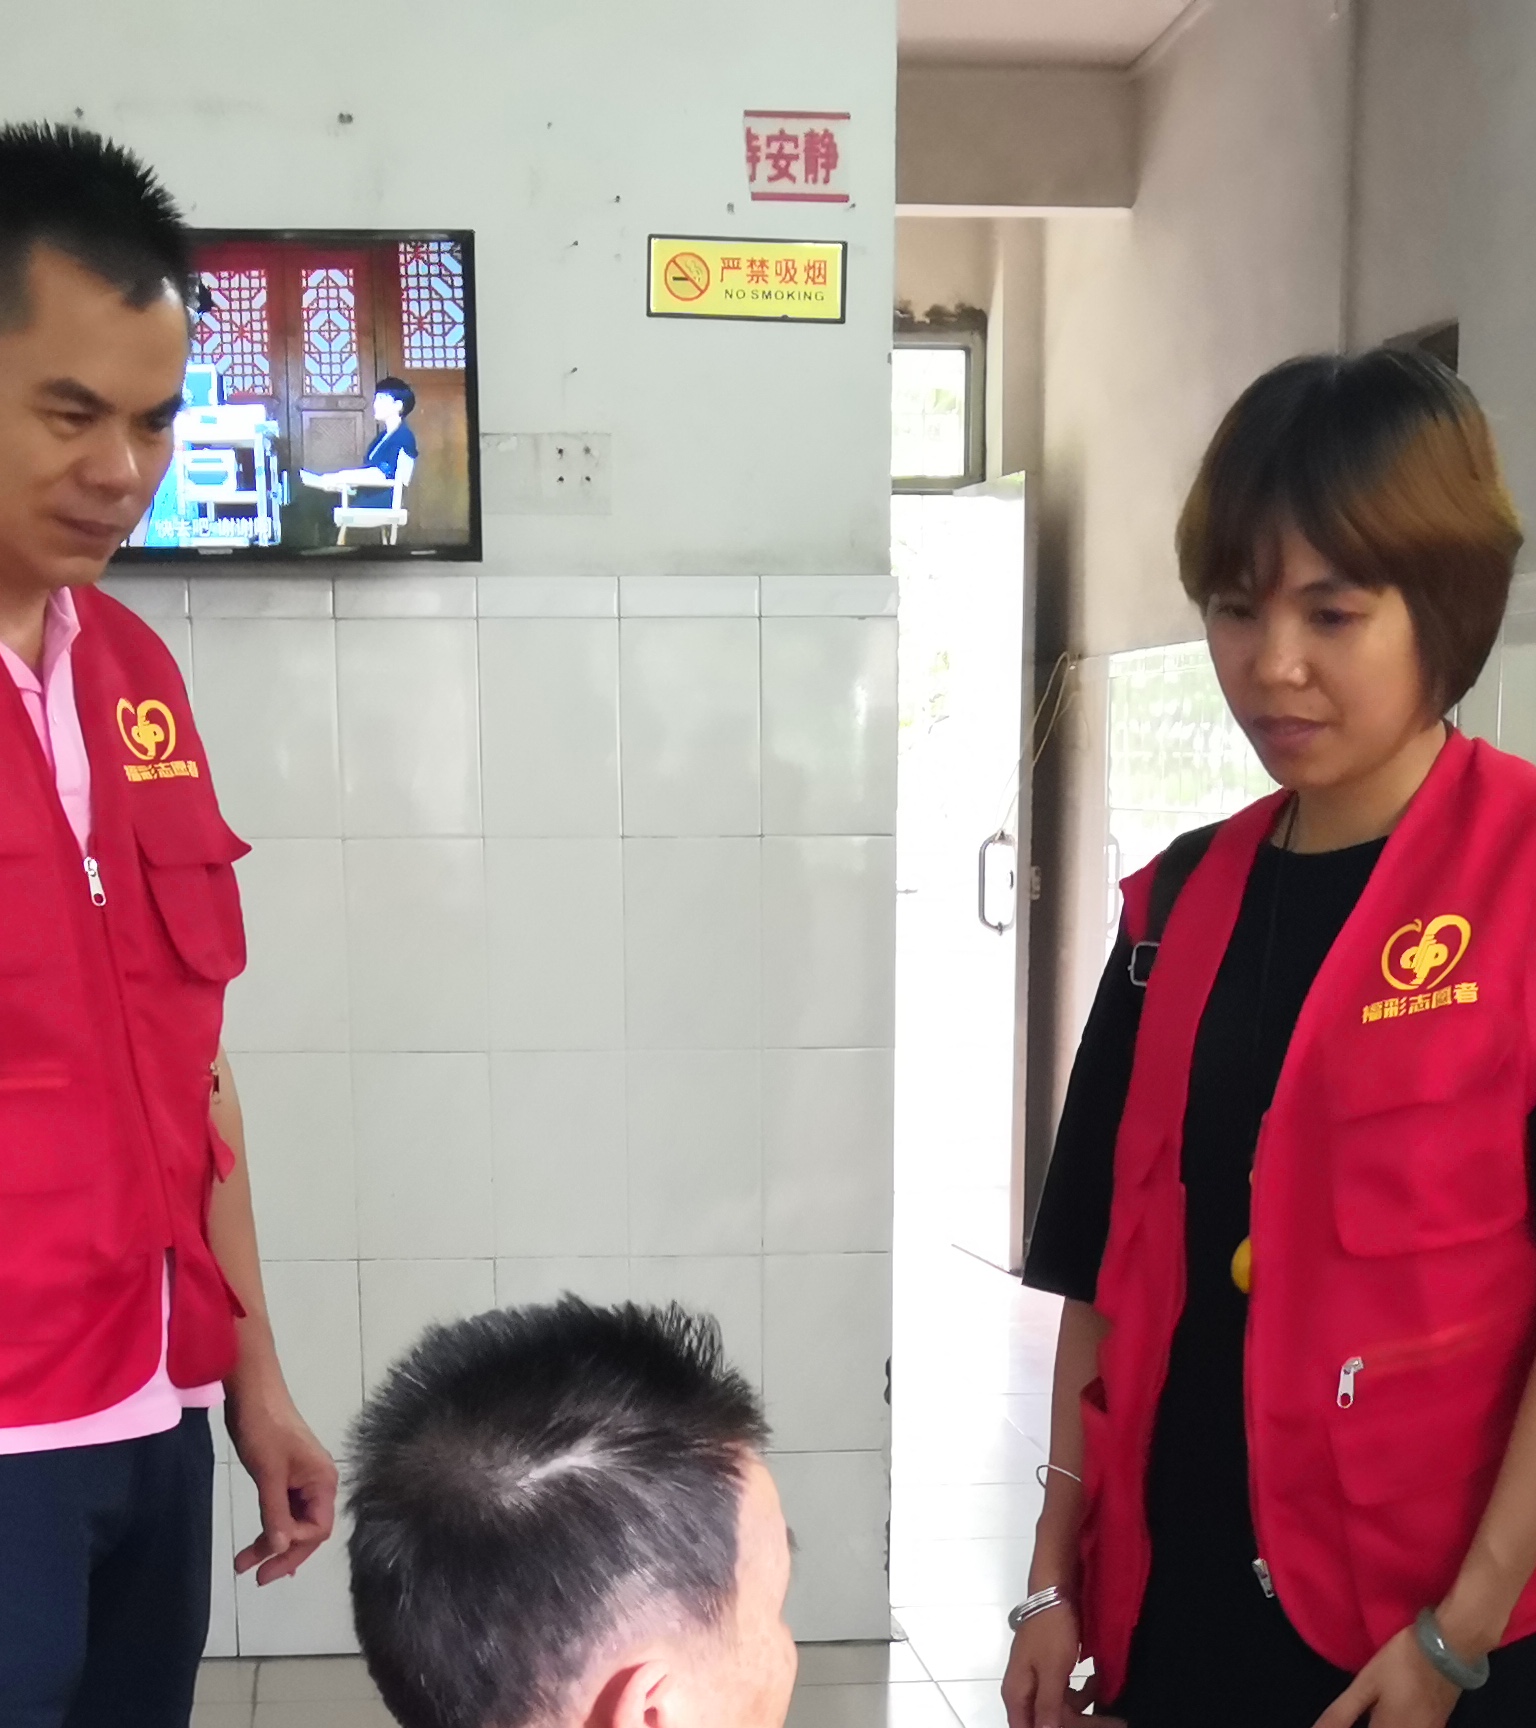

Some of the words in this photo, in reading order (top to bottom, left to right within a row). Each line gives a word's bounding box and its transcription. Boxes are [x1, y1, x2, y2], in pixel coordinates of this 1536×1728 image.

[720, 257, 827, 286] 严禁吸烟
[724, 288, 746, 300] NO
[751, 289, 825, 302] SMOKING
